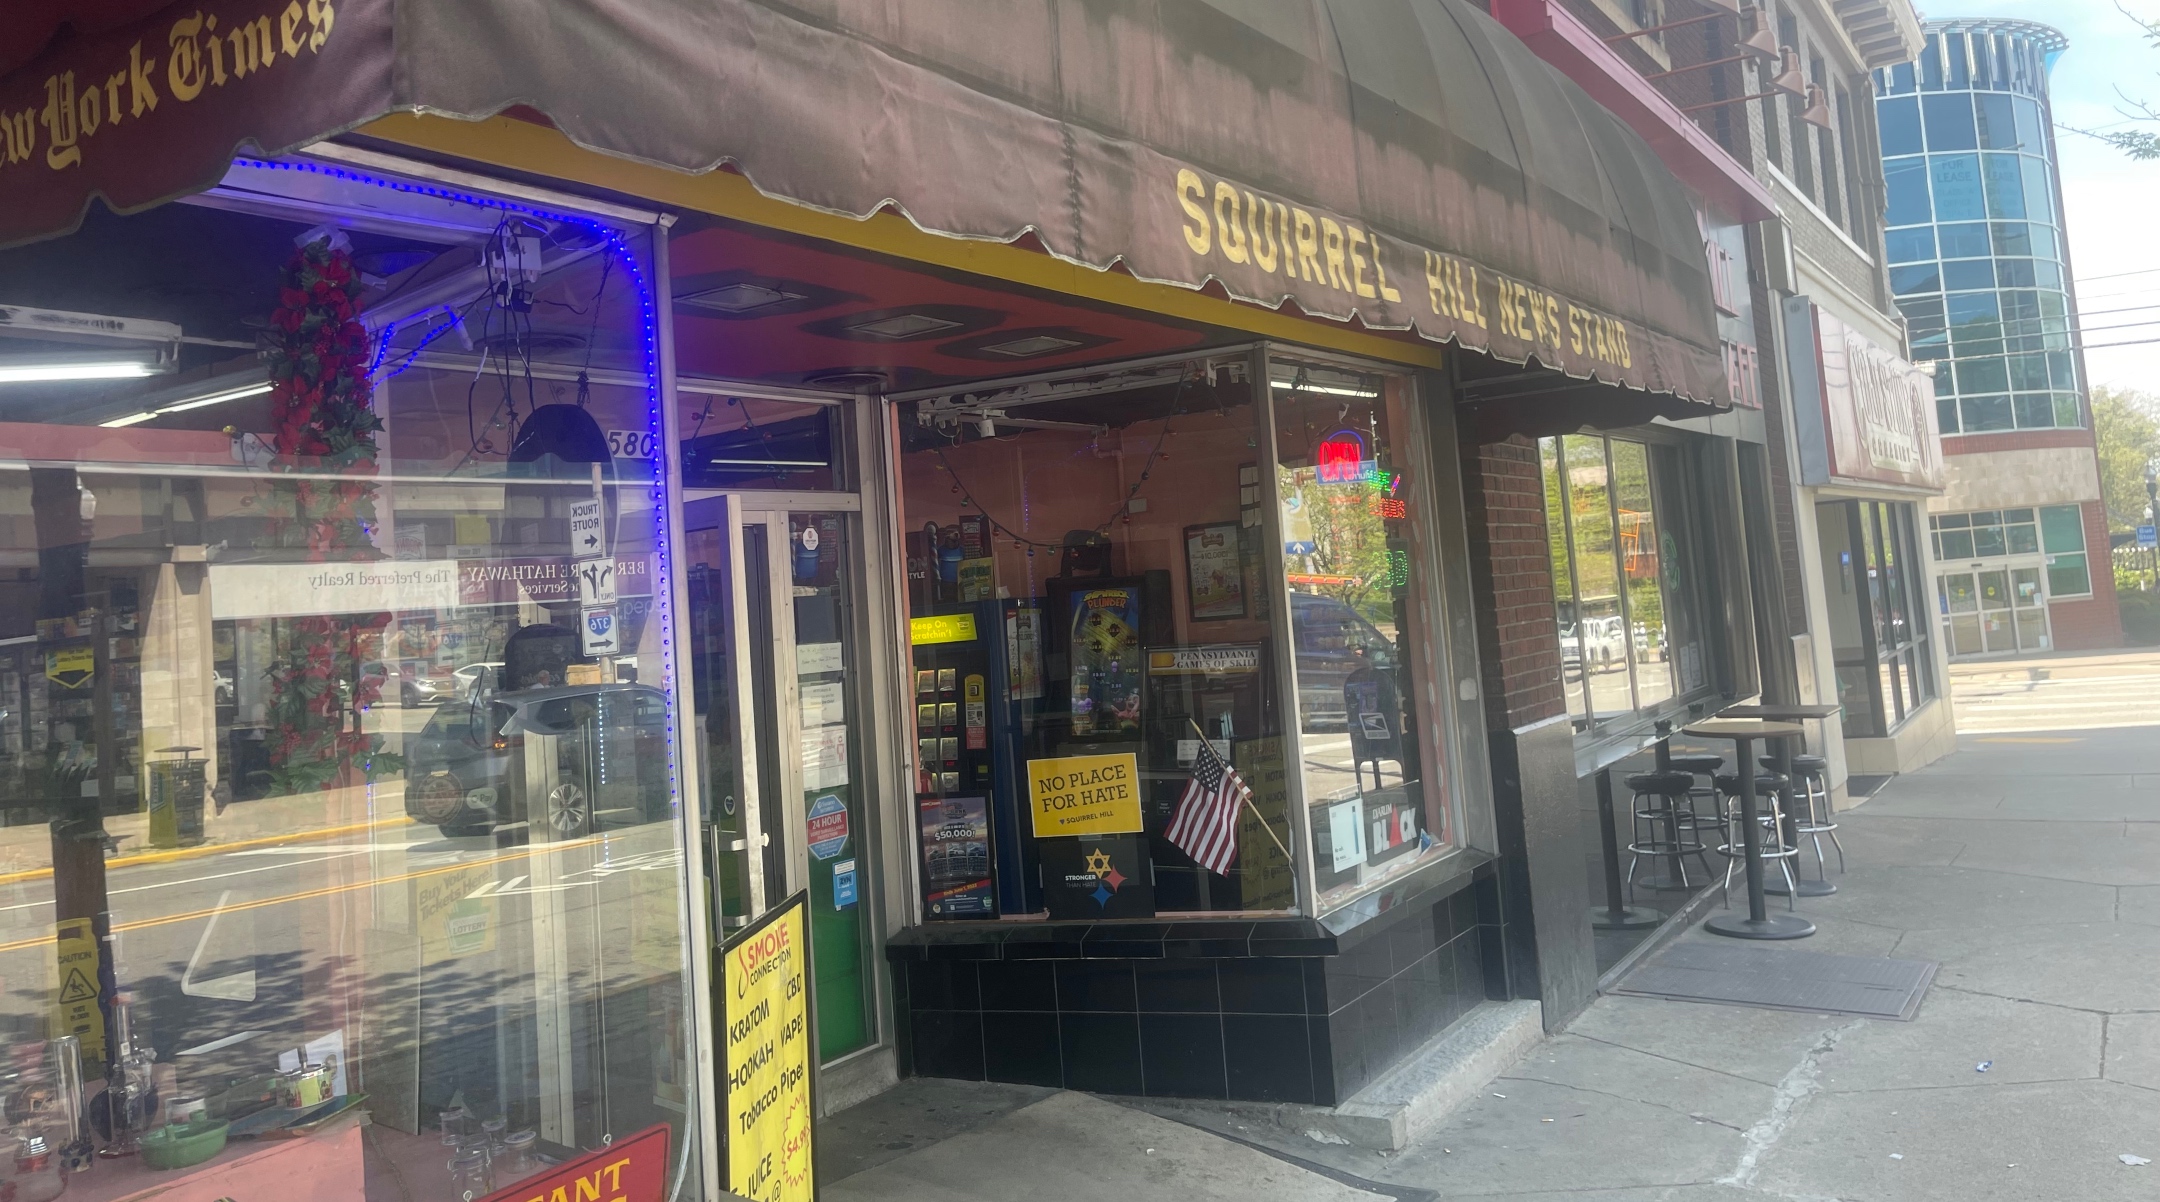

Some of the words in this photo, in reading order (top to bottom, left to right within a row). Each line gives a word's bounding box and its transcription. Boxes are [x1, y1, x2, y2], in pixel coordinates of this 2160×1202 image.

[41, 39, 159, 170] York
[168, 0, 334, 101] Times
[1942, 160, 1964, 170] FOR
[1937, 171, 1973, 183] LEASE
[1177, 168, 1401, 304] SQUIRREL
[1425, 250, 1487, 330] HILL
[1498, 276, 1561, 349] NEWS
[1569, 302, 1631, 369] STAND
[1088, 599, 1127, 609] PLUNDER
[911, 621, 932, 631] Keep
[934, 620, 947, 628] On
[1177, 660, 1210, 669] GAMES
[1181, 651, 1255, 660] PENNSYLVANIA
[1039, 776, 1065, 793] NO
[1069, 764, 1126, 787] PLACE
[480, 793, 493, 804] Pay
[1042, 794, 1077, 812] FOR
[1081, 784, 1128, 806] HATE
[812, 820, 820, 829] 24
[822, 814, 842, 827] HOUR
[1066, 812, 1098, 824] SQUIRREL
[1100, 810, 1114, 818] HILL
[934, 829, 976, 841] $50,000!
[419, 883, 443, 906] Buy
[443, 867, 468, 890] Your
[420, 887, 461, 921] Tickets
[462, 865, 494, 894] Here!
[452, 921, 487, 935] LOTTERY
[748, 922, 790, 969] SMOKE
[58, 952, 92, 964] CAUTION
[750, 947, 792, 986] CONNECTION
[786, 973, 801, 1001] CBD
[730, 998, 770, 1047] KRATOM
[729, 1039, 774, 1095] HOOKAH
[739, 1085, 778, 1135] Tobacco
